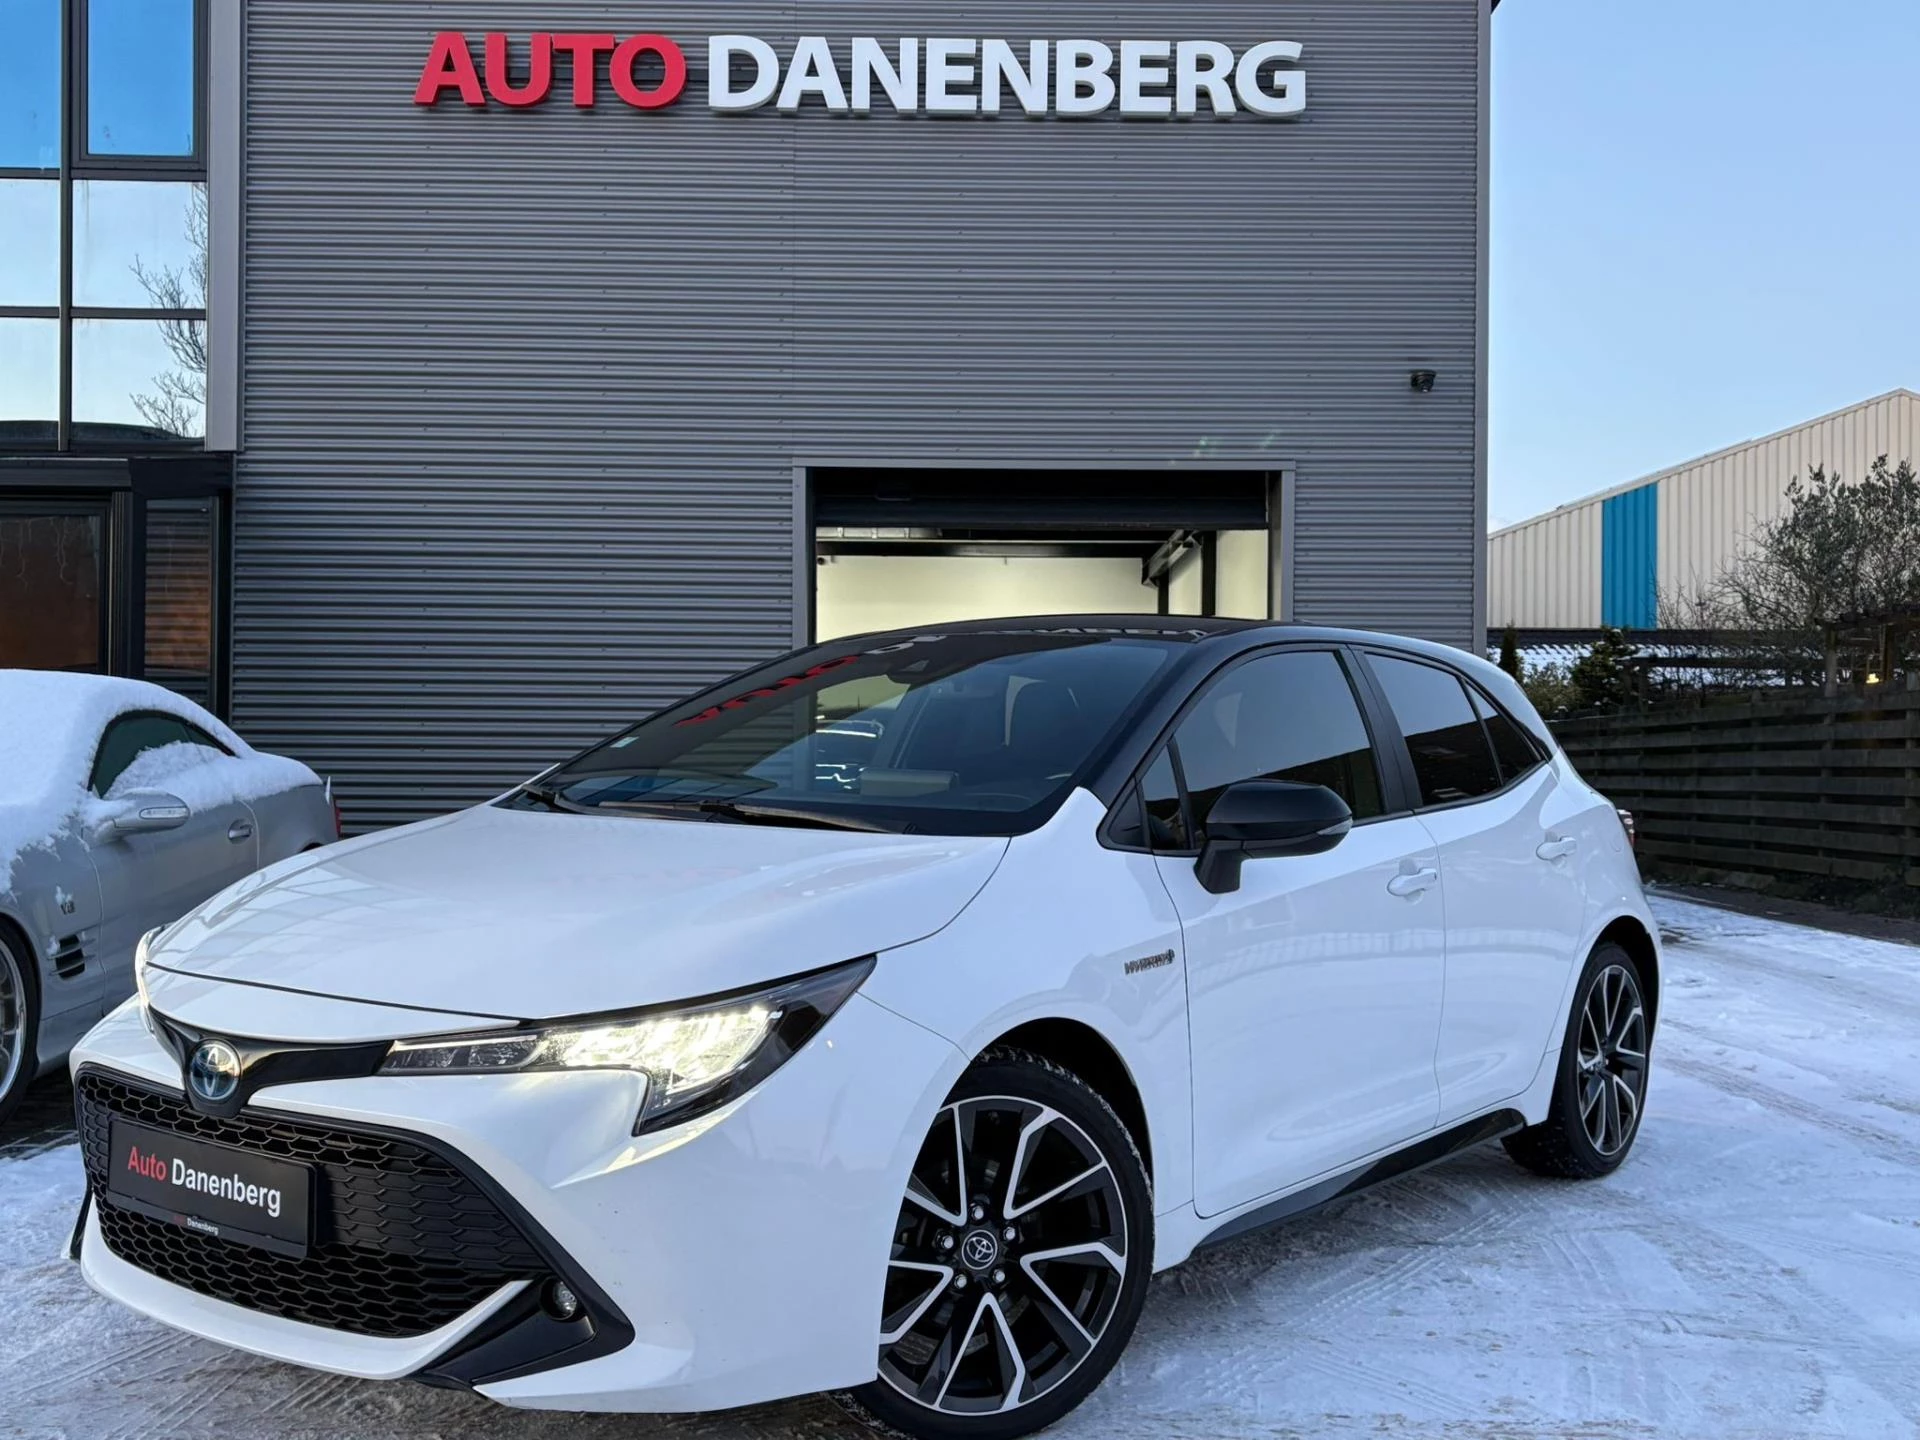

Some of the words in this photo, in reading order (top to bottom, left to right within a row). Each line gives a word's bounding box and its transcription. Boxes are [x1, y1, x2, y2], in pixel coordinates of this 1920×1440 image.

[415, 32, 687, 109] AUTO
[708, 34, 1308, 117] DANENBERG
[127, 1146, 167, 1181] Auto
[171, 1158, 281, 1217] Danenberg
